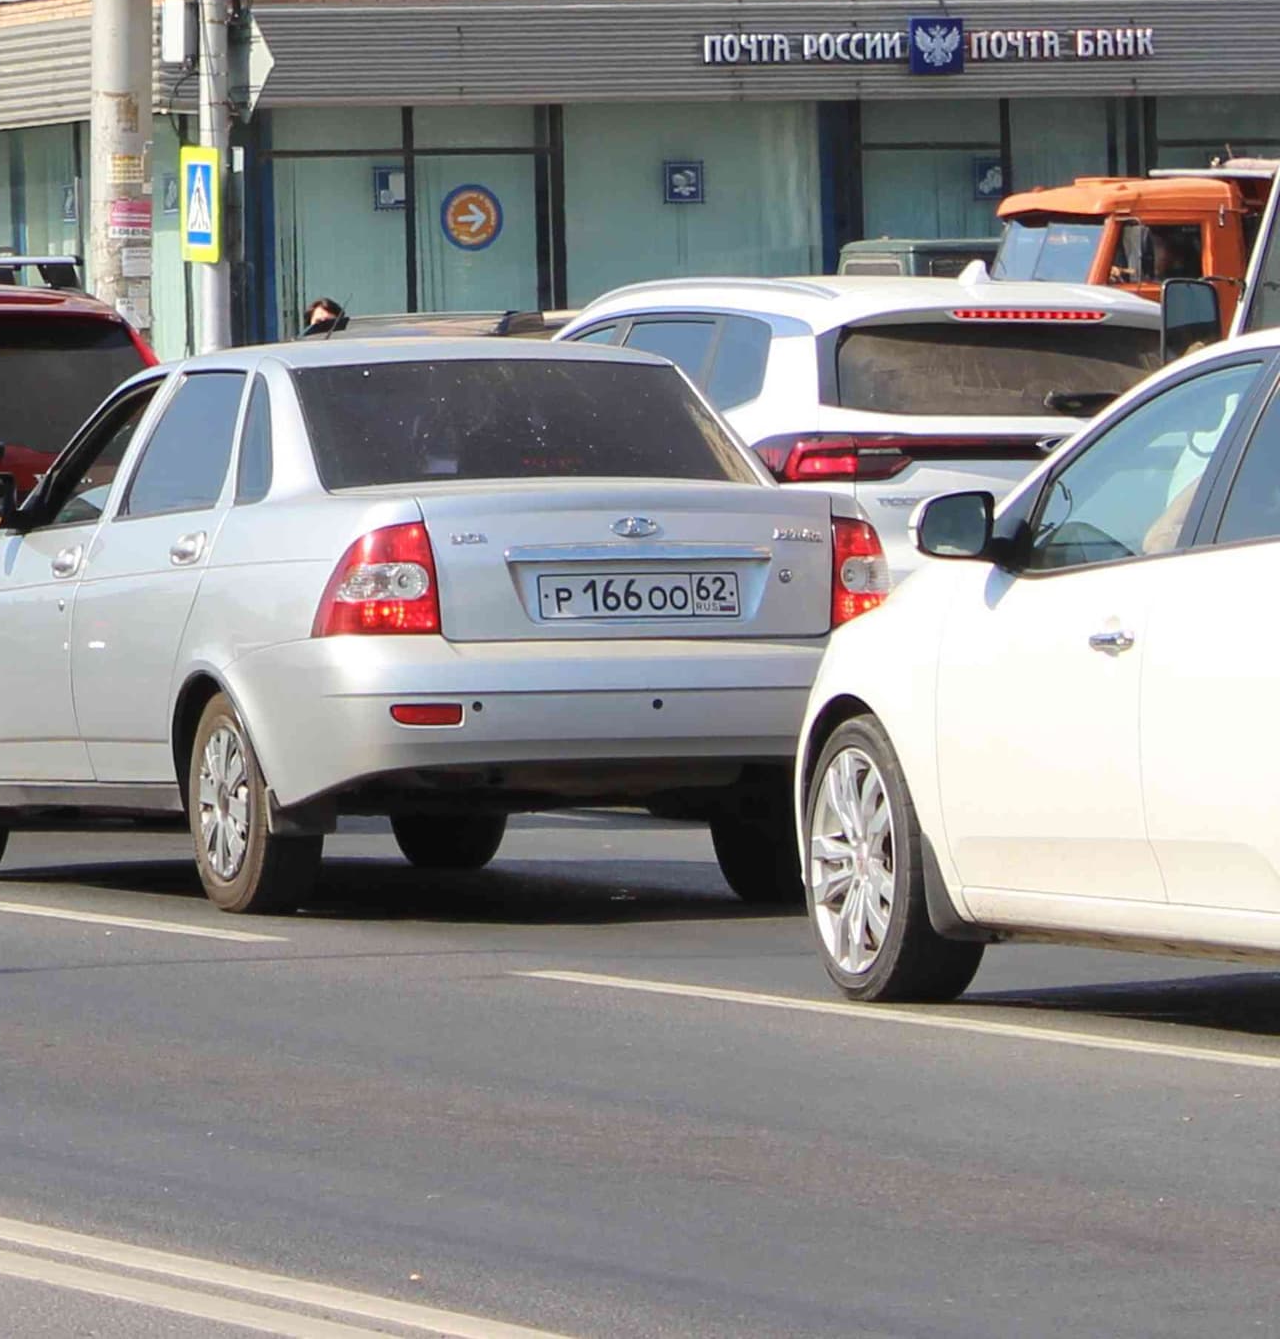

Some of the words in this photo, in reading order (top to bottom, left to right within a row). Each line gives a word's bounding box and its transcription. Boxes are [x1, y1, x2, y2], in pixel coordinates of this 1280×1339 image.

[704, 33, 790, 62] ПОЧТА
[803, 31, 902, 61] РОССИИ
[971, 30, 1061, 60] ПОЧТА
[1076, 27, 1155, 57] БАНК
[695, 576, 727, 601] 62
